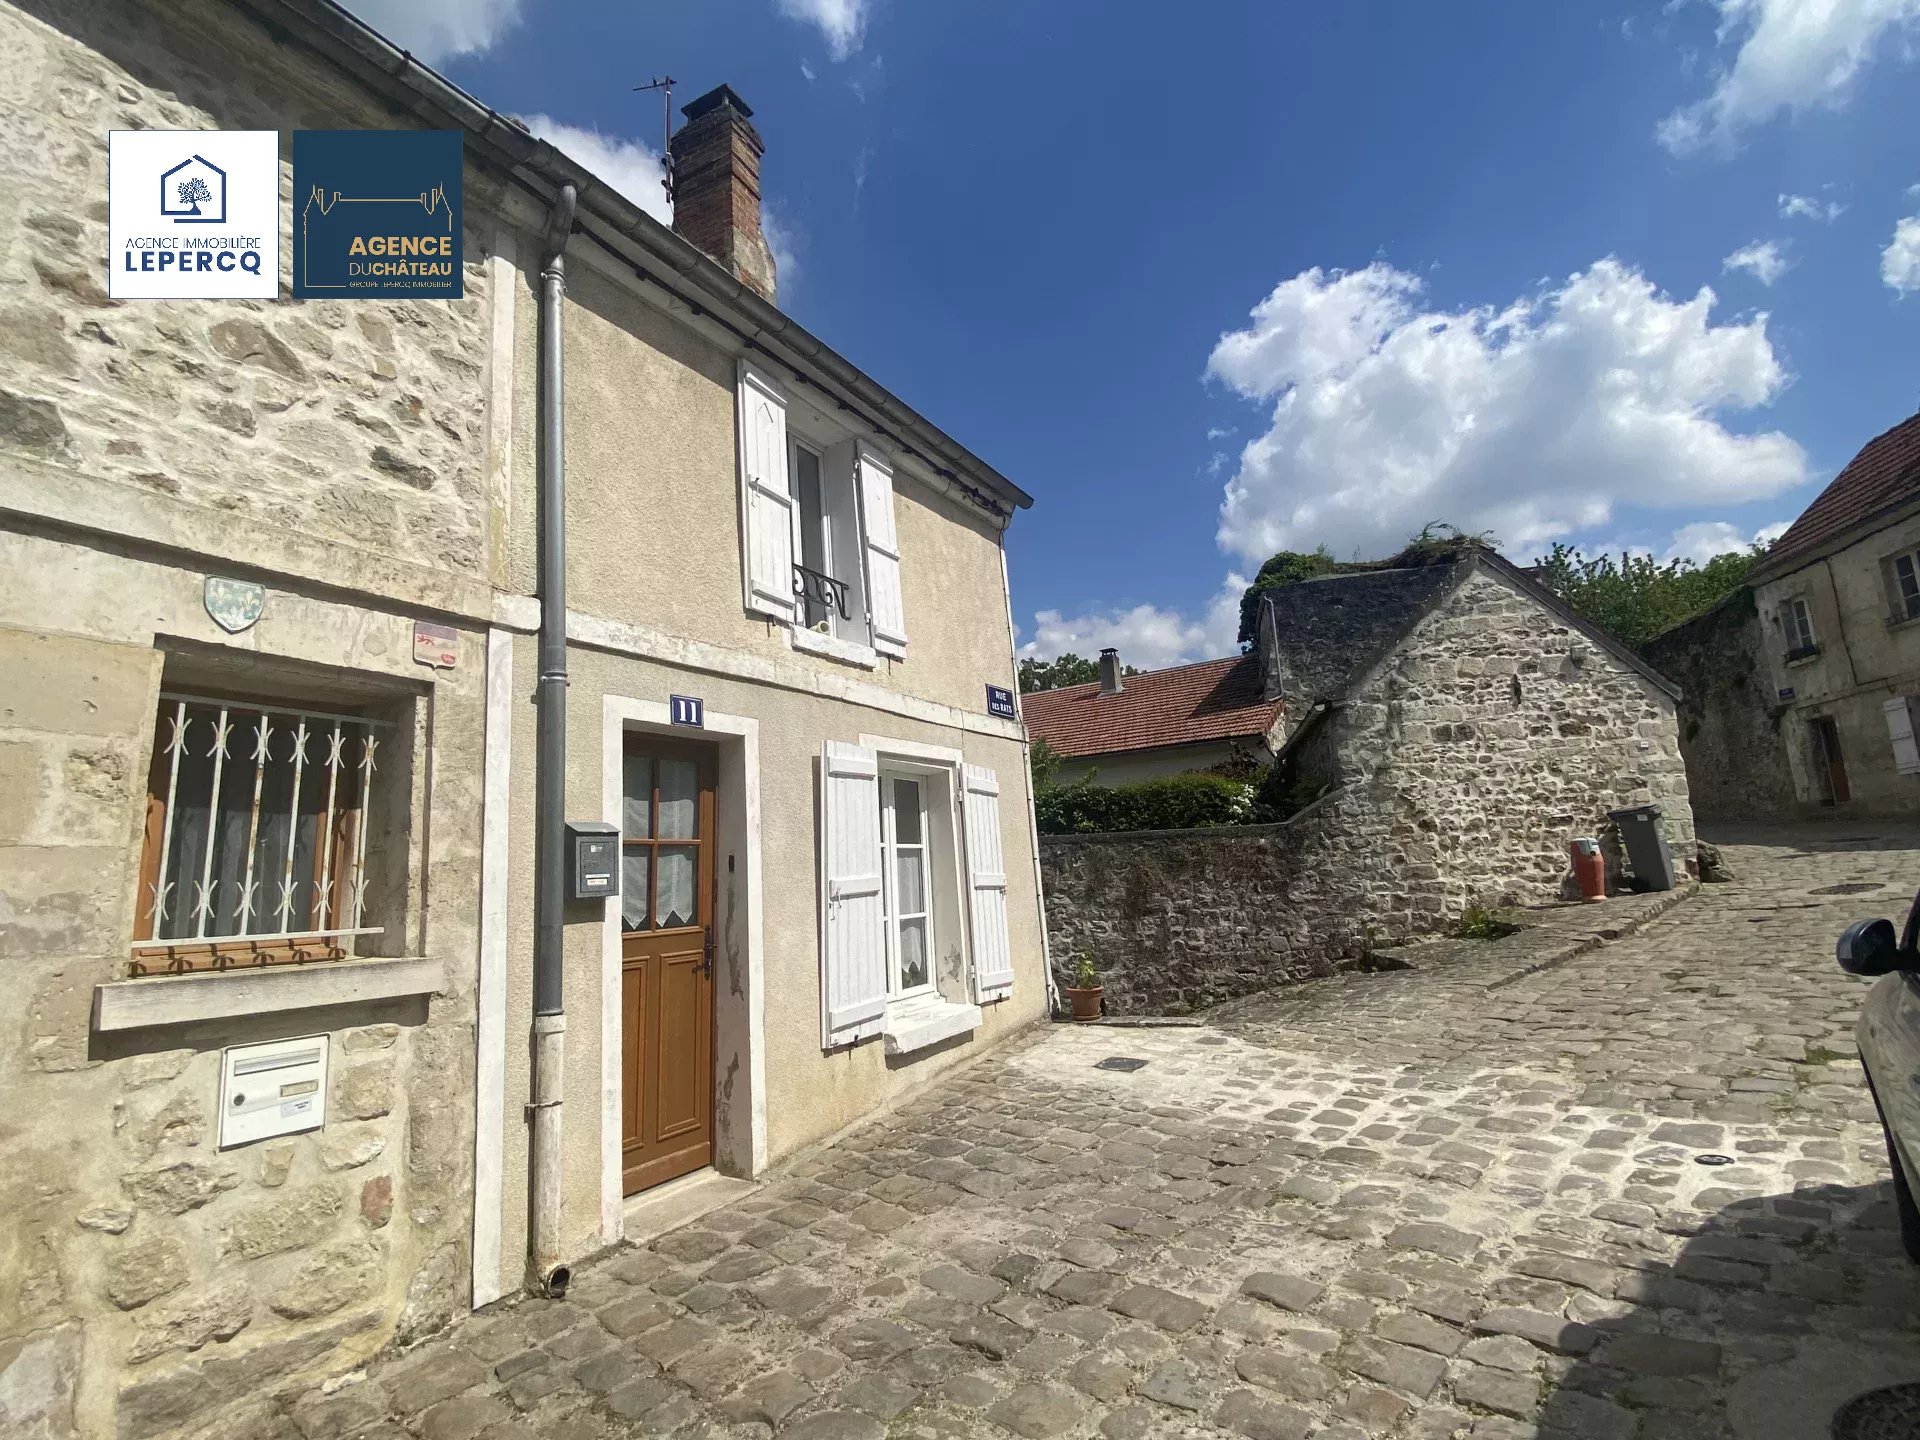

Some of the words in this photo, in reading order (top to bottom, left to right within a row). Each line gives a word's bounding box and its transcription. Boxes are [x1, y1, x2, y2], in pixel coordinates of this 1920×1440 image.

[995, 691, 1007, 701] RUE
[679, 700, 697, 722] 11
[1000, 703, 1013, 714] RATS
